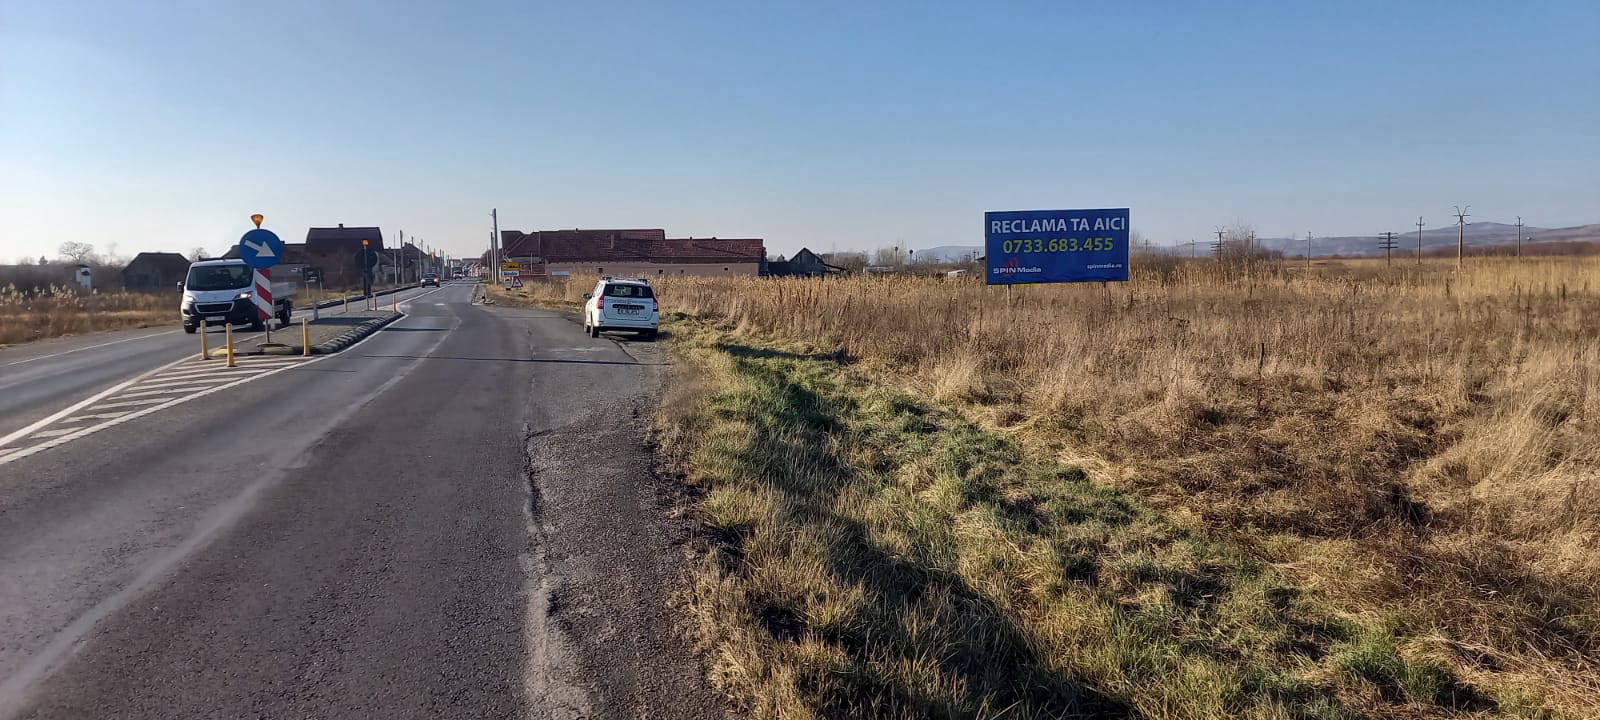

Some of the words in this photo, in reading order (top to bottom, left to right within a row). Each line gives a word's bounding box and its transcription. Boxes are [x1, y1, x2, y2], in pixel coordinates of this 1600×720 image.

[991, 219, 1067, 233] RECLAMA
[1070, 218, 1090, 231] TA
[1093, 217, 1125, 231] AICI
[1002, 237, 1114, 253] 0733.683.455
